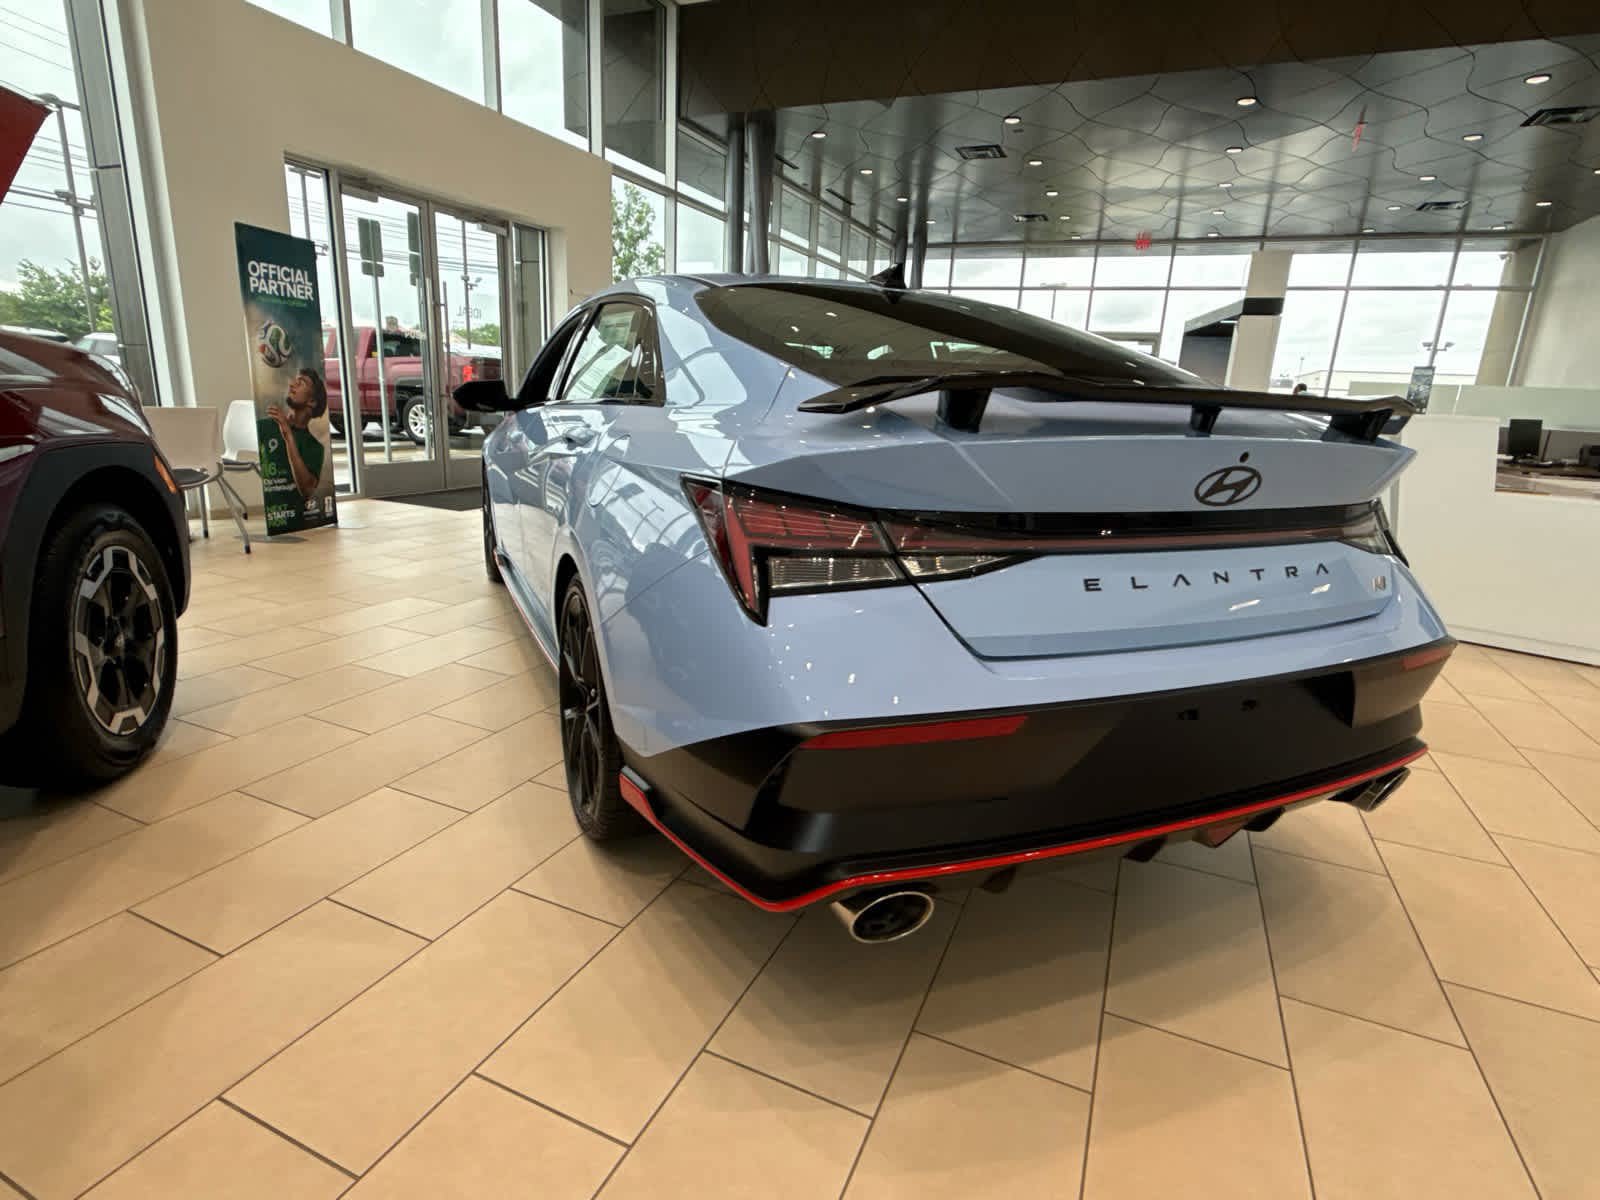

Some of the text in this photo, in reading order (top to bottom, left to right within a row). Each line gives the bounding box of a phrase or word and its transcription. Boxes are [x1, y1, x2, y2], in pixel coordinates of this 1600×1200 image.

[248, 260, 313, 286] OFFICIAL
[249, 276, 314, 301] PARTNER
[268, 438, 279, 453] 9
[267, 510, 296, 521] STARTS
[1083, 563, 1330, 593] ELANTRA
